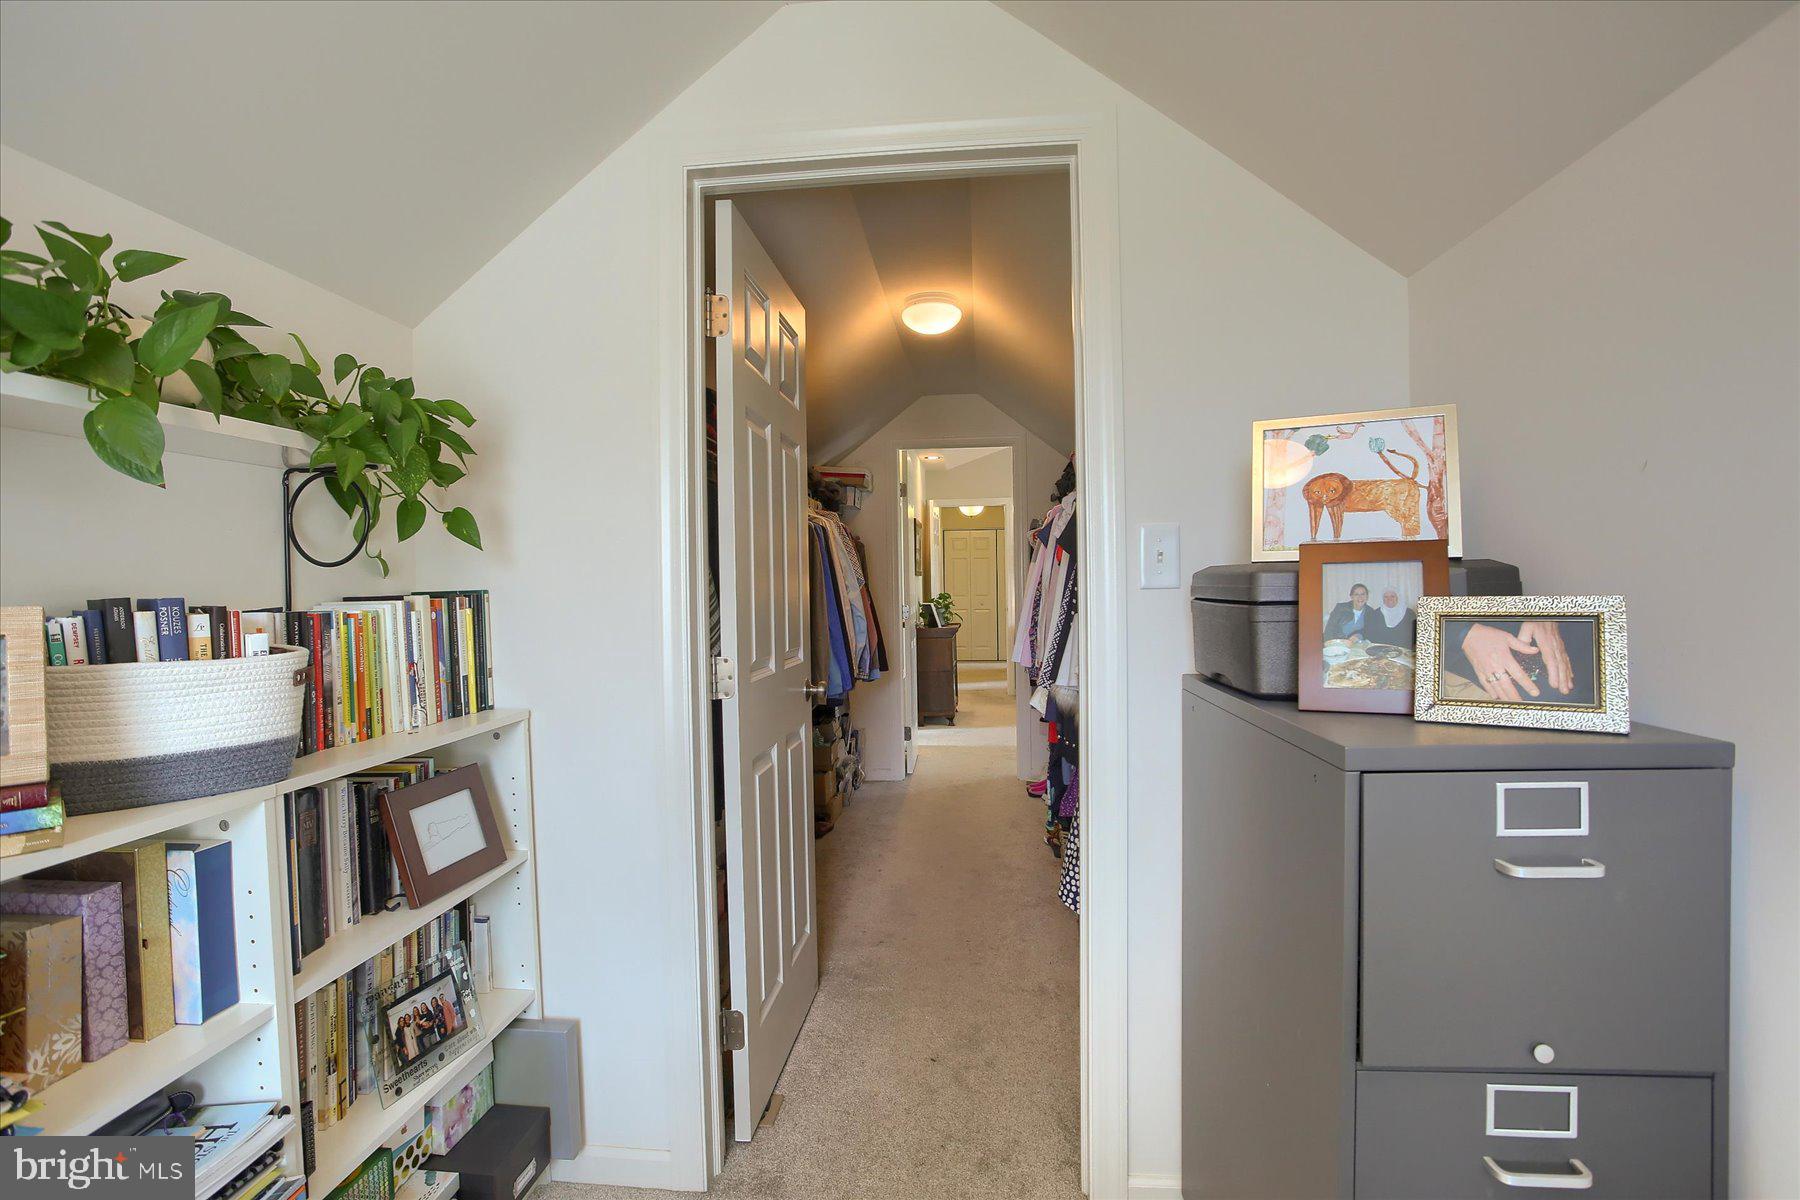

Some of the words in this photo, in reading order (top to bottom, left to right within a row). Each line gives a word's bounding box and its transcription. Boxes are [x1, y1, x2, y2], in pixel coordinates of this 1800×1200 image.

[159, 606, 169, 636] POSNER
[172, 606, 182, 634] KOUZES
[71, 623, 79, 648] DEMPSEY
[383, 1059, 428, 1094] Sweethearts
